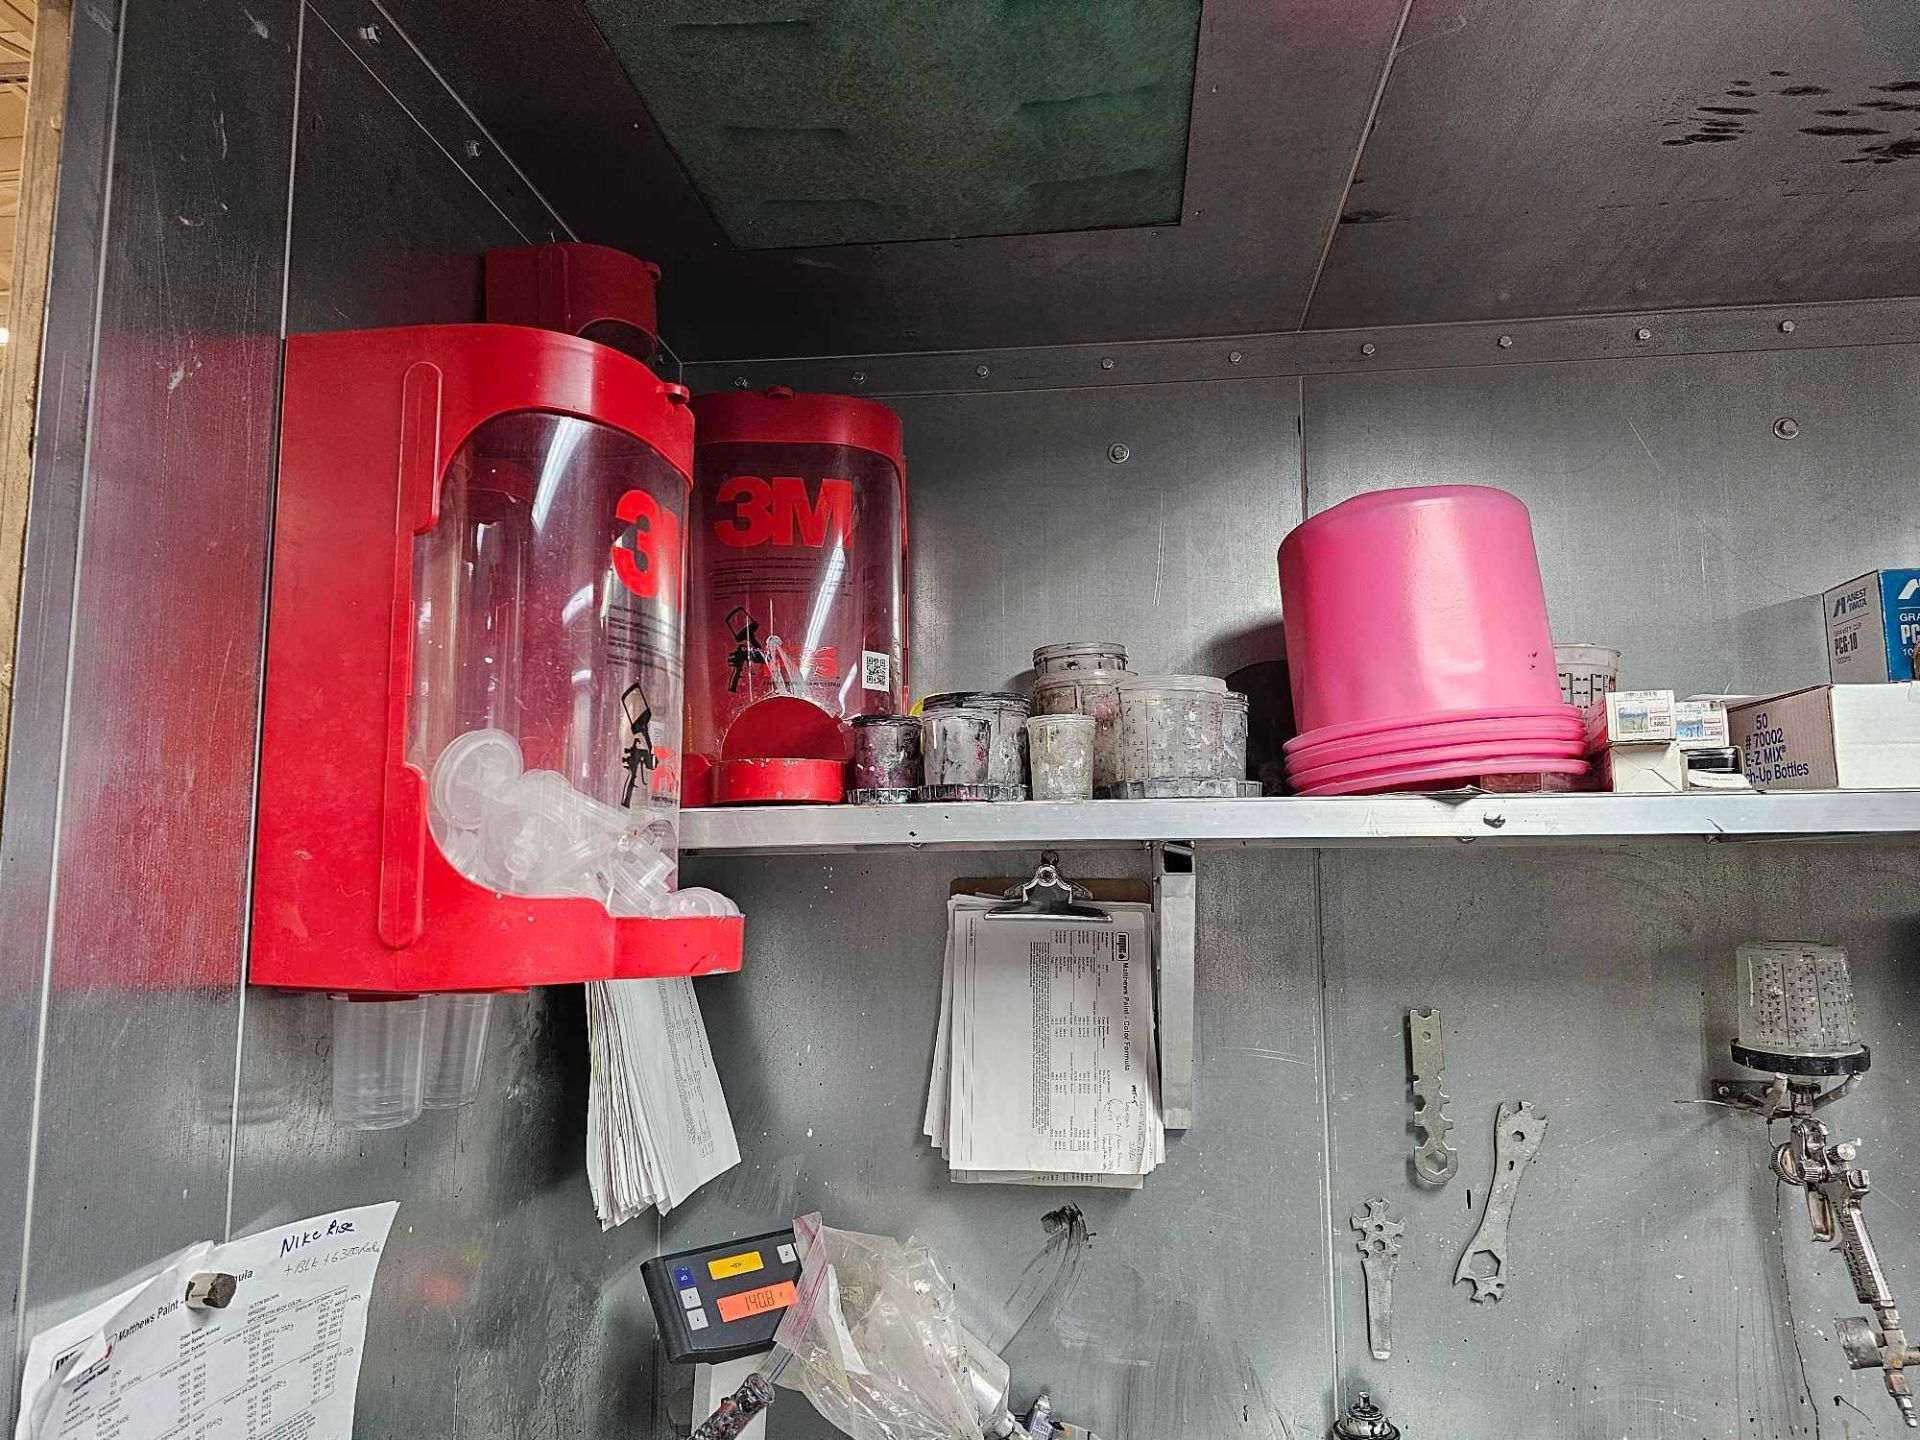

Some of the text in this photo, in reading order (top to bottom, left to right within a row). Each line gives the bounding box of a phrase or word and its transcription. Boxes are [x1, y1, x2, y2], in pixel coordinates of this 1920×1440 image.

[714, 476, 852, 548] 3M
[1846, 588, 1867, 603] ANEST
[1834, 632, 1858, 656] PCG-10
[1756, 713, 1768, 730] 50
[1753, 727, 1784, 748] 70002
[1745, 750, 1762, 768] E-Z
[1774, 760, 1809, 780] Bottles
[1123, 1042, 1131, 1071] Formula
[118, 1315, 155, 1342] Matthews
[157, 1304, 179, 1319] Paint
